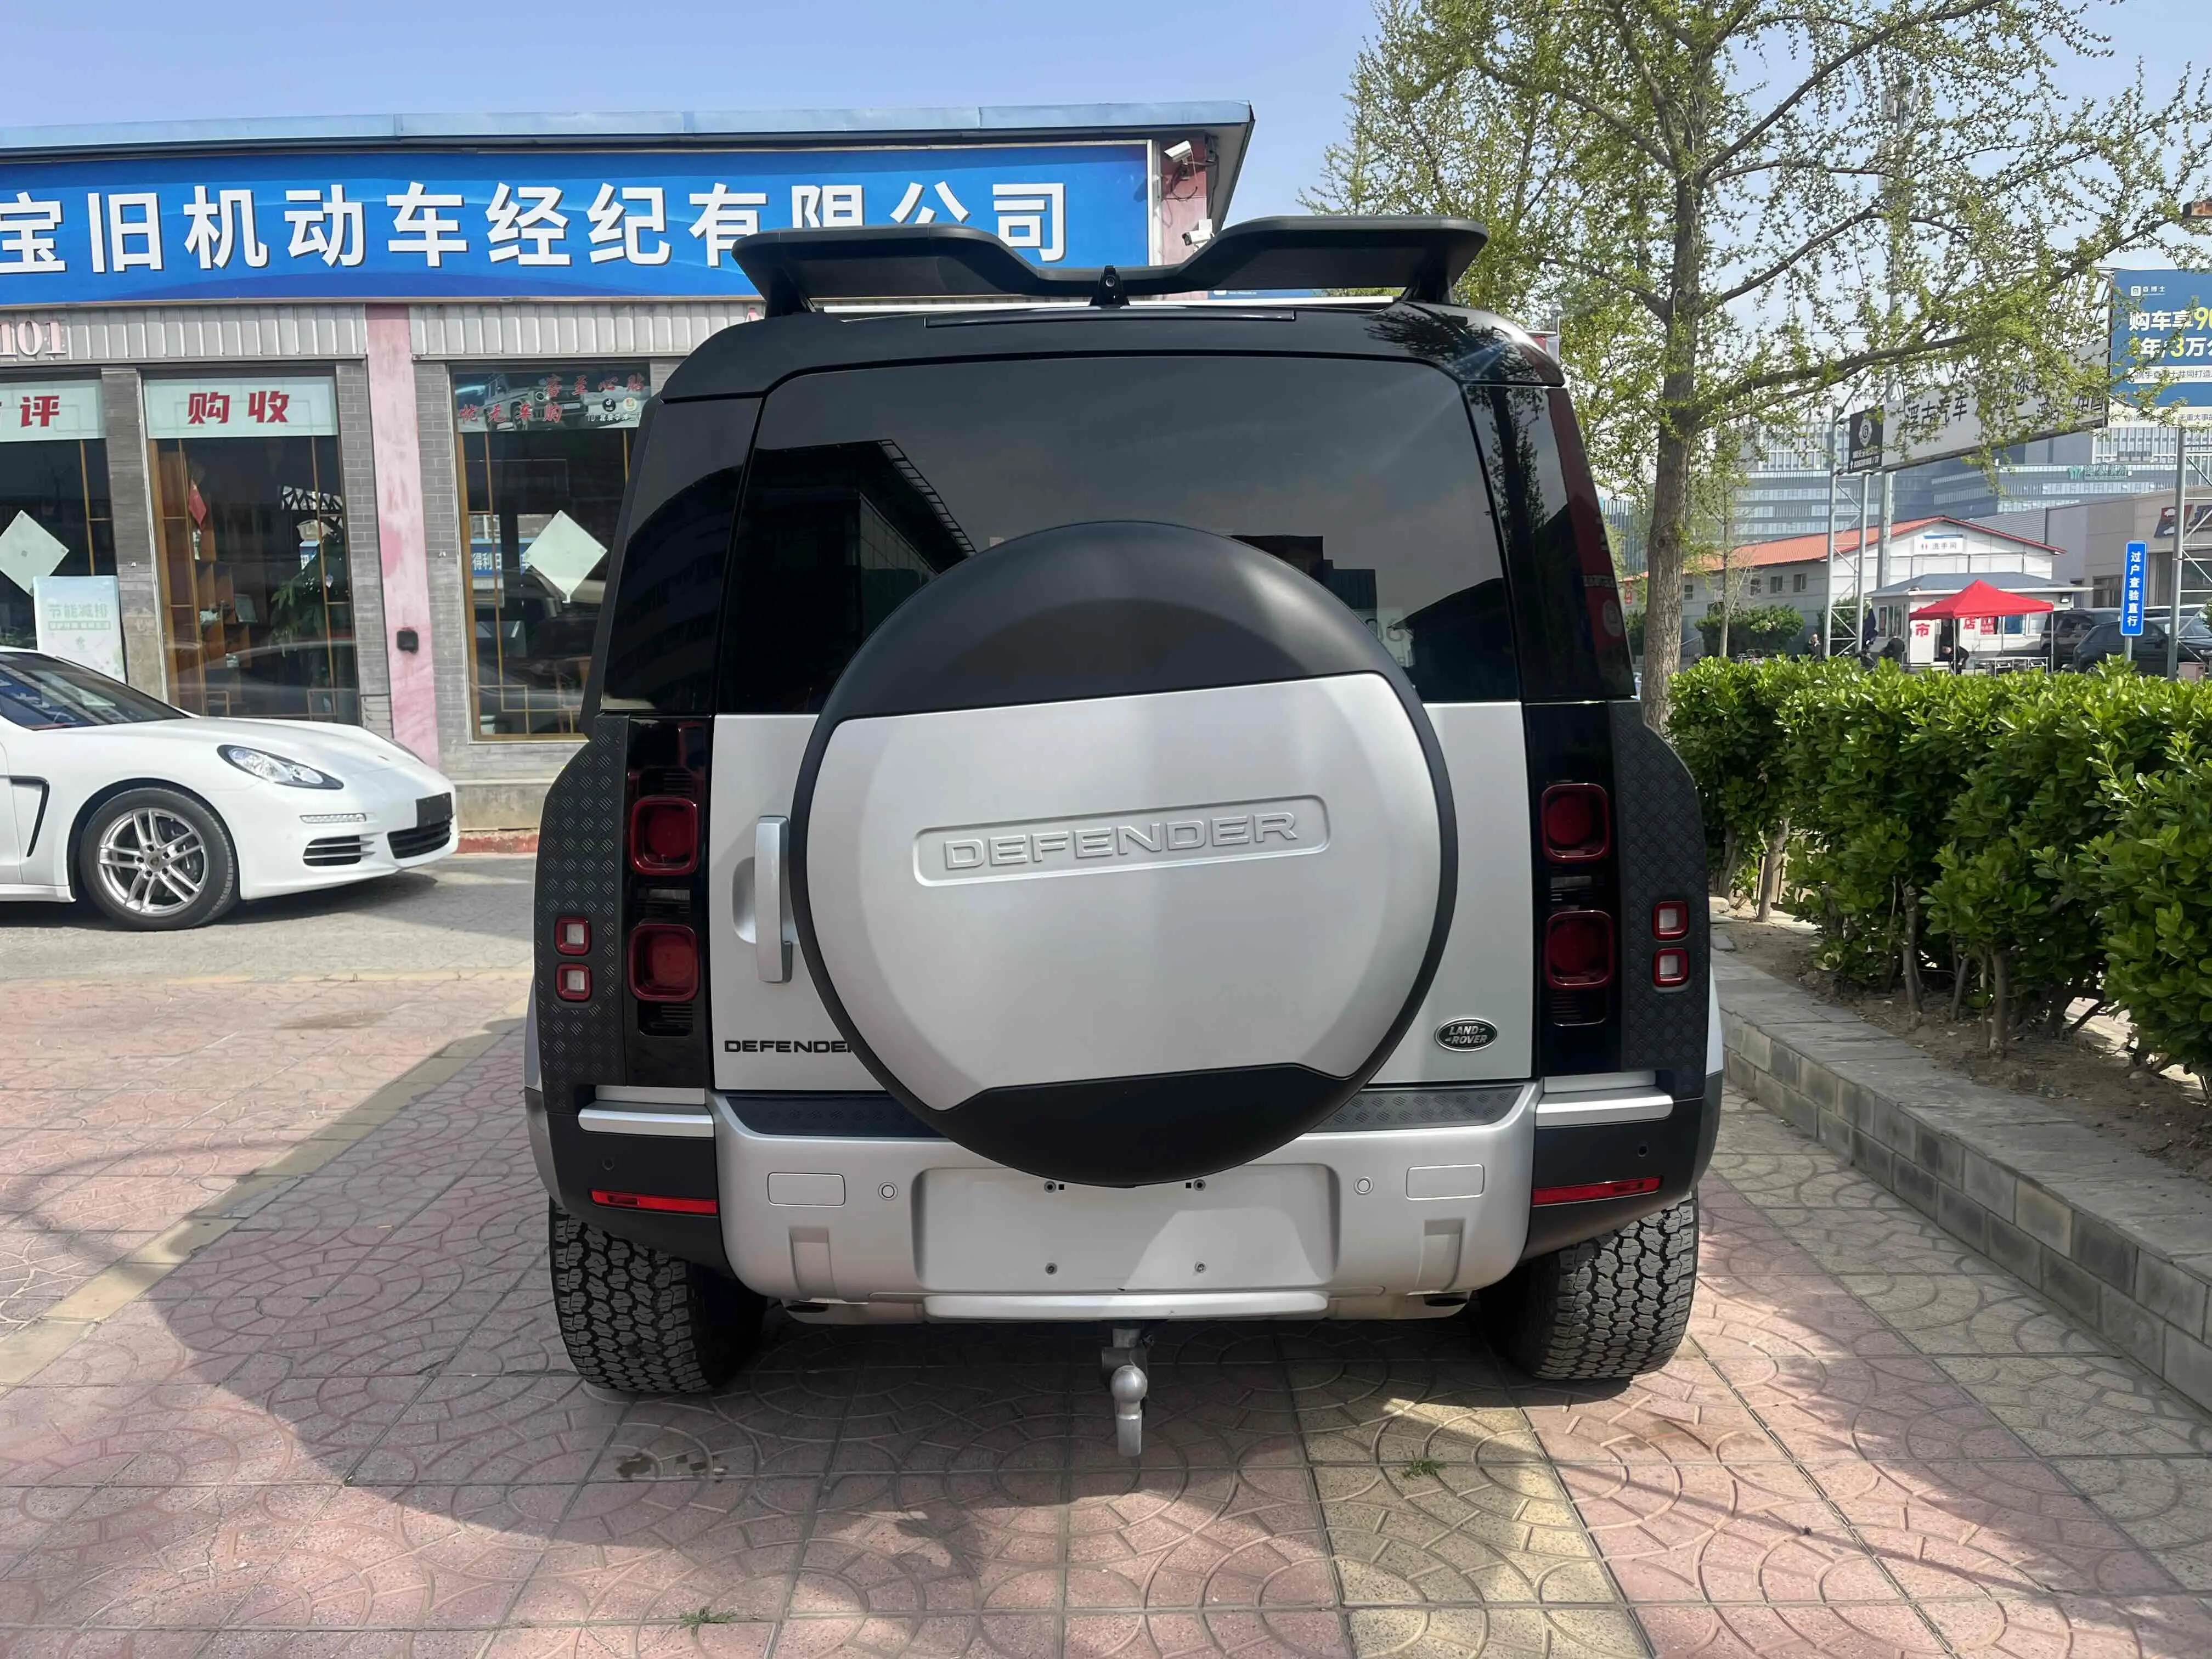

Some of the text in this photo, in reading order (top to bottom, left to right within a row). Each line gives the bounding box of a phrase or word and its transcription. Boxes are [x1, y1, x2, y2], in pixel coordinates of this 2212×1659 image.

[2129, 306, 2212, 331] 购车享9
[20, 395, 60, 427] 评
[2127, 551, 2141, 627] 过户查验直行
[1915, 623, 1931, 637] 市
[943, 812, 1298, 871] DEFENDER
[1448, 1025, 1479, 1036] LAND
[1451, 1034, 1488, 1045] ROVER
